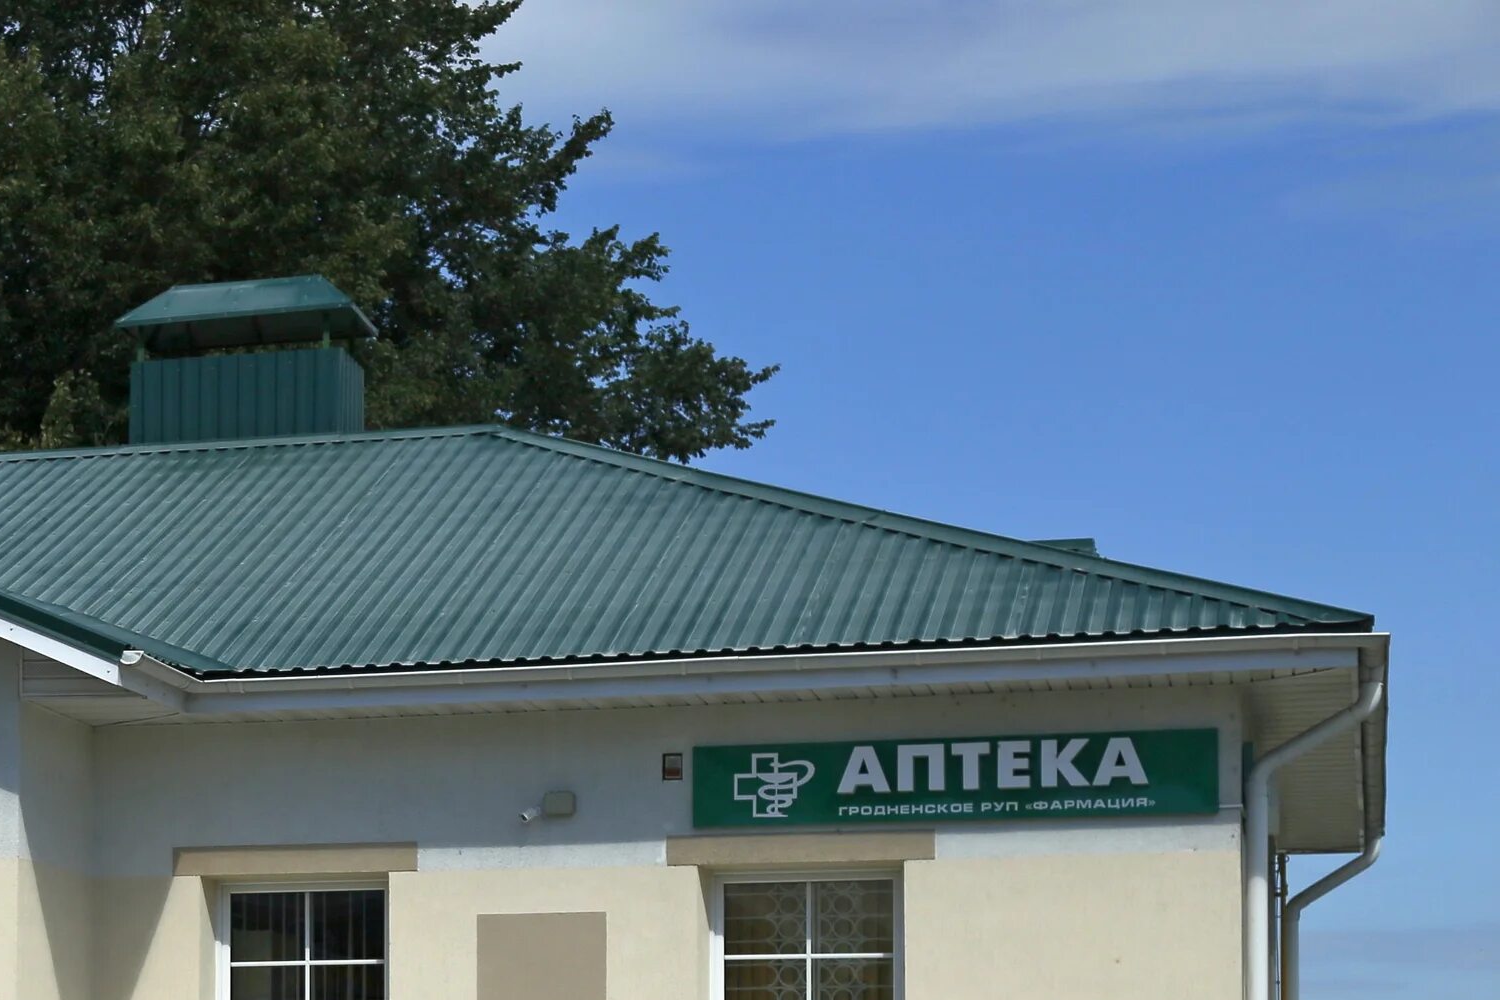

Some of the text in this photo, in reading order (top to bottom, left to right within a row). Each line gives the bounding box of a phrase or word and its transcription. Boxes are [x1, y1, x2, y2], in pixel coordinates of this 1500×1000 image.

[836, 736, 1149, 794] АПТЕКА
[838, 797, 1156, 816] ГРОДНЕНСКОЕ РУП «ФАРМАЦИЯ»
